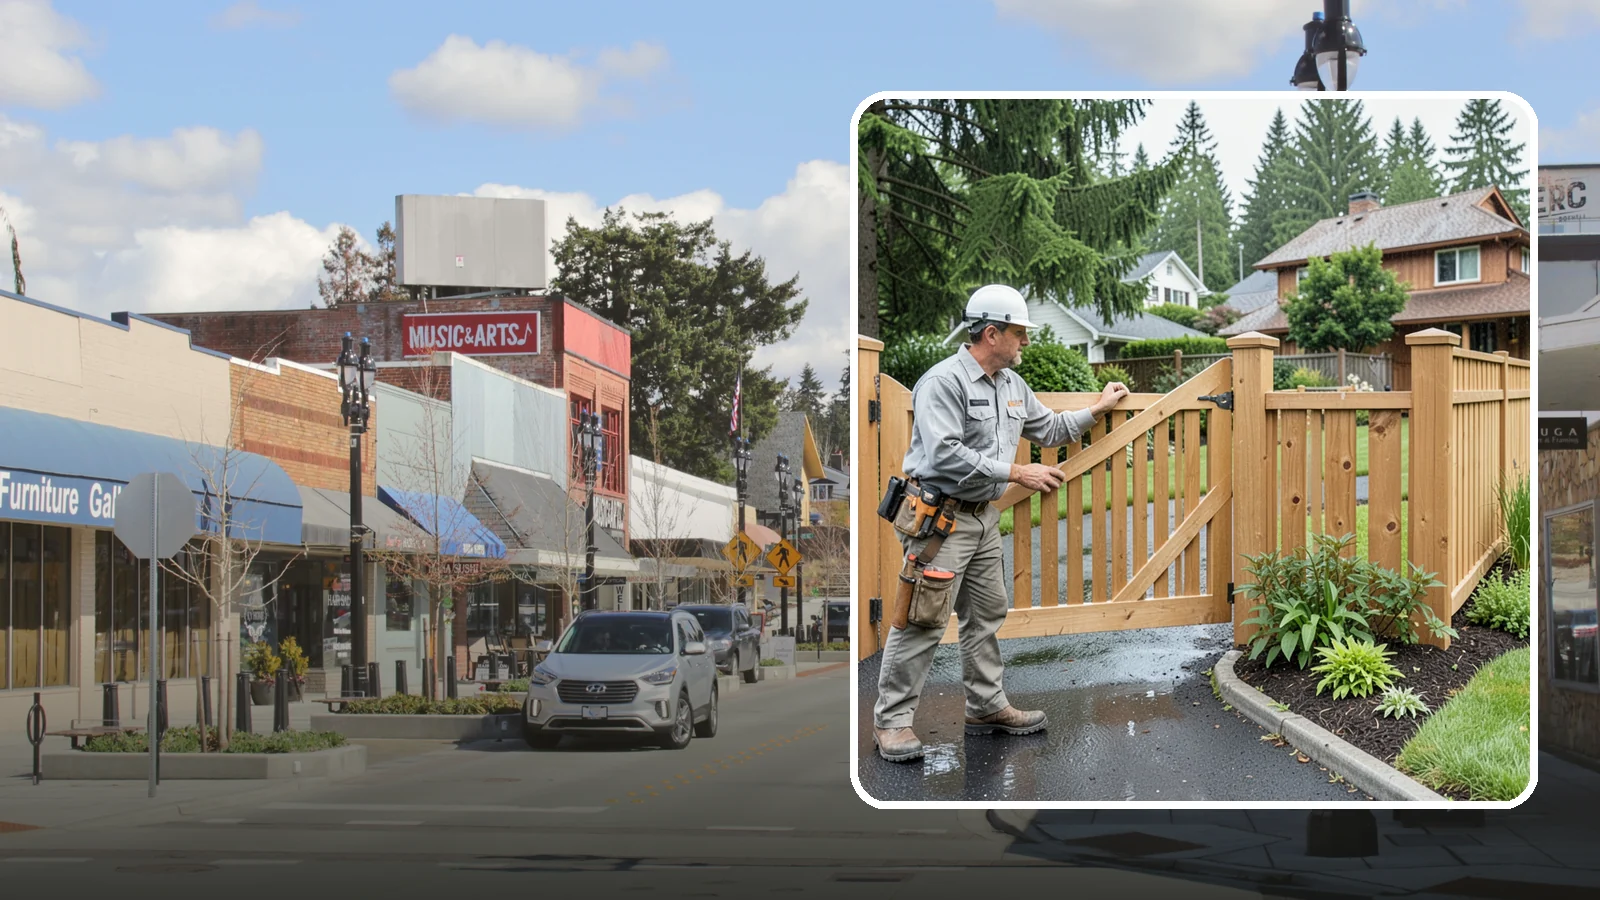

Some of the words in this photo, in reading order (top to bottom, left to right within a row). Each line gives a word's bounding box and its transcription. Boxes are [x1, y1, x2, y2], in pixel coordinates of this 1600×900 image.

[409, 323, 519, 348] MUSIC&ARTS
[0, 471, 79, 515] Furniture
[89, 482, 121, 519] Gal
